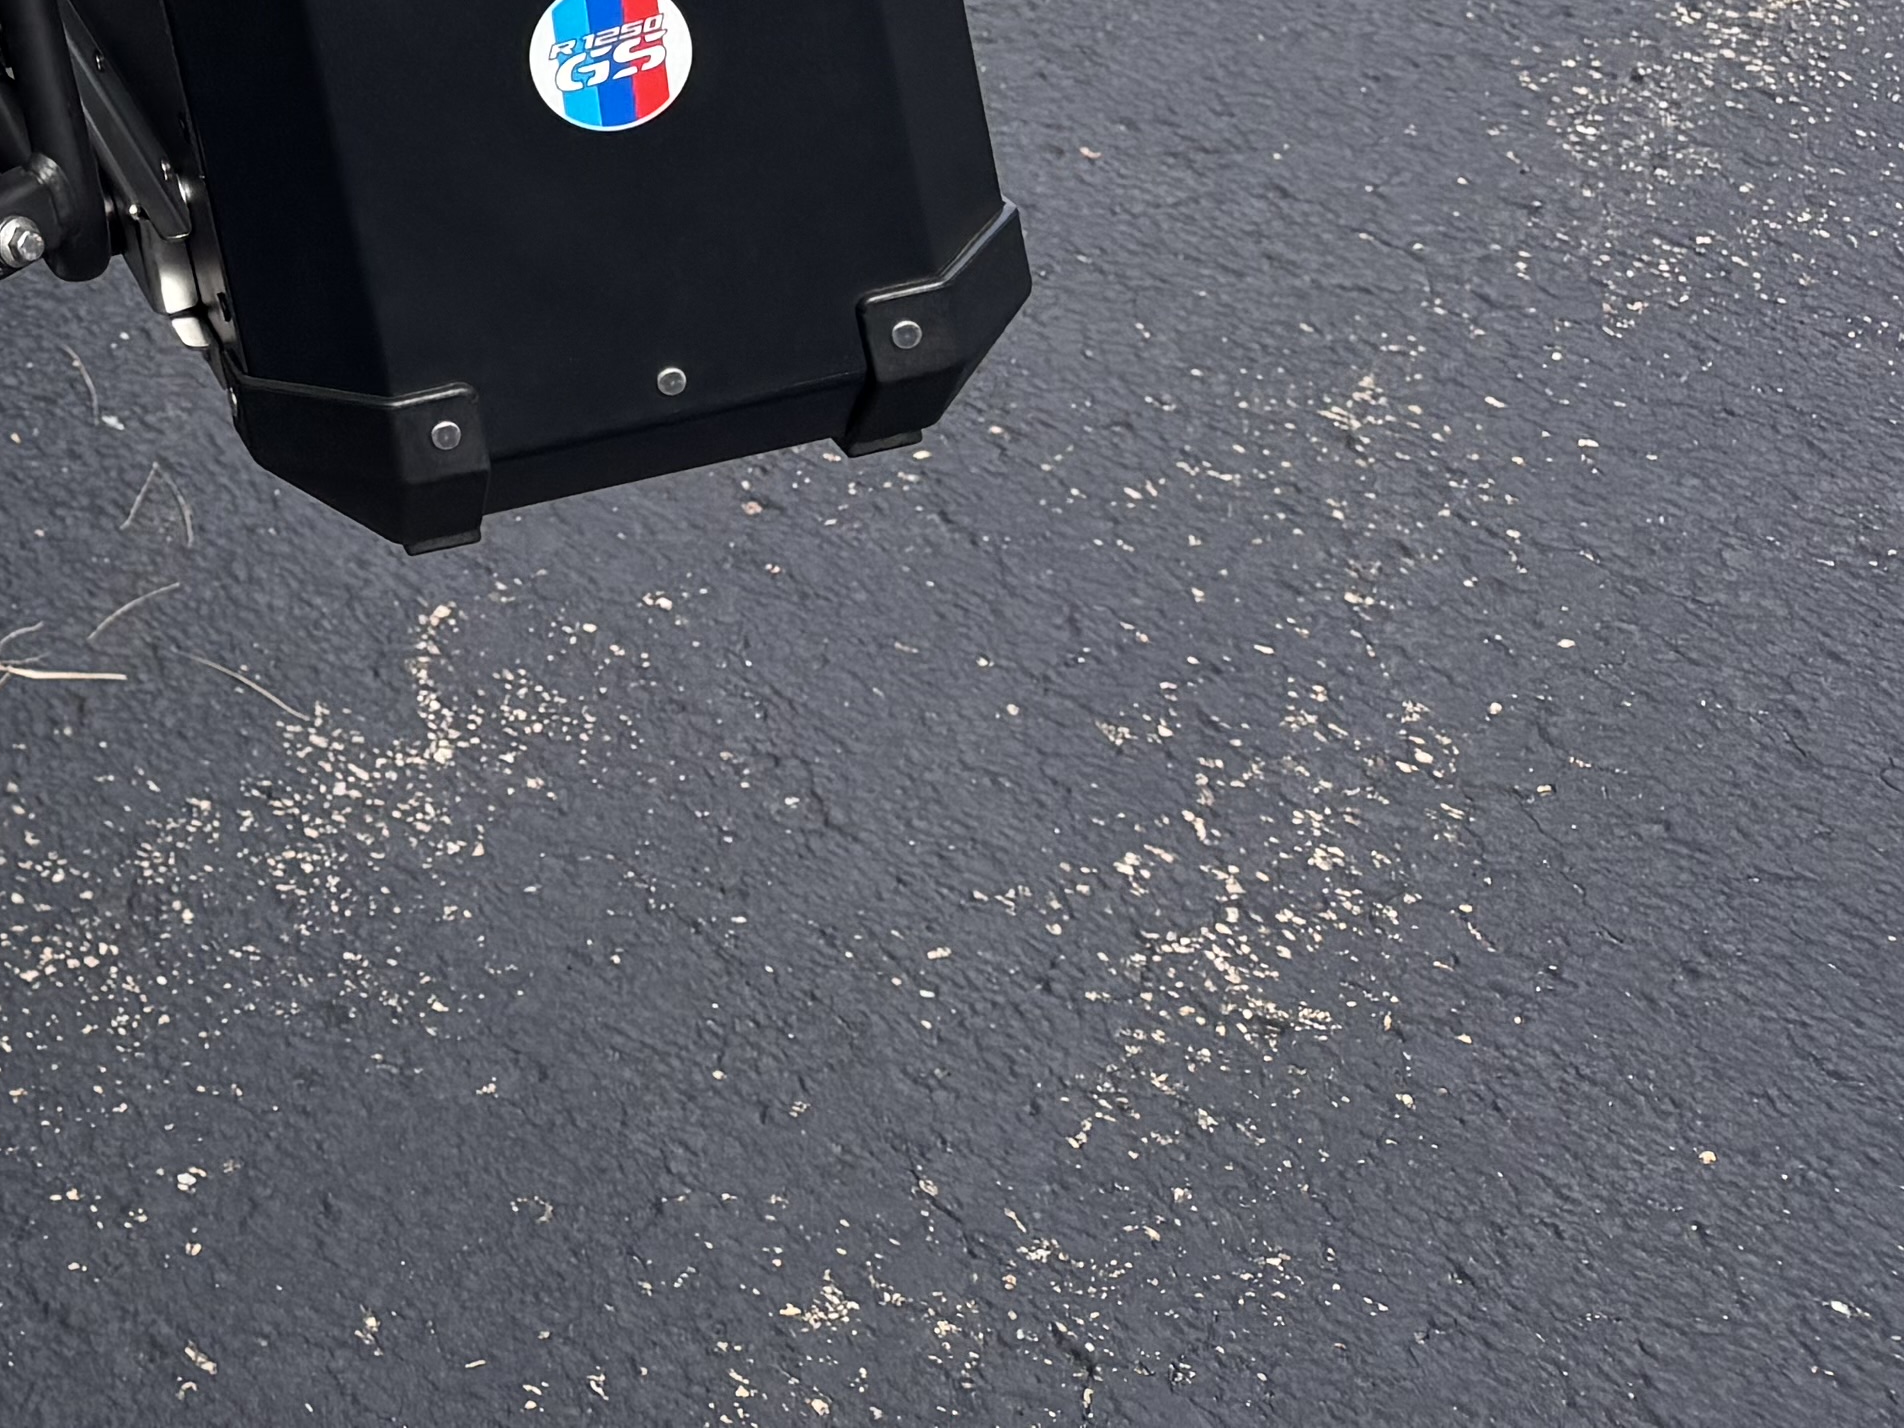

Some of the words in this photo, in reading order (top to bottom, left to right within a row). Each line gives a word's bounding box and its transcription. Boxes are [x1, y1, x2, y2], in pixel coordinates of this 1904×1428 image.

[548, 38, 577, 61] R
[580, 12, 664, 50] 1250
[554, 28, 668, 92] GS
